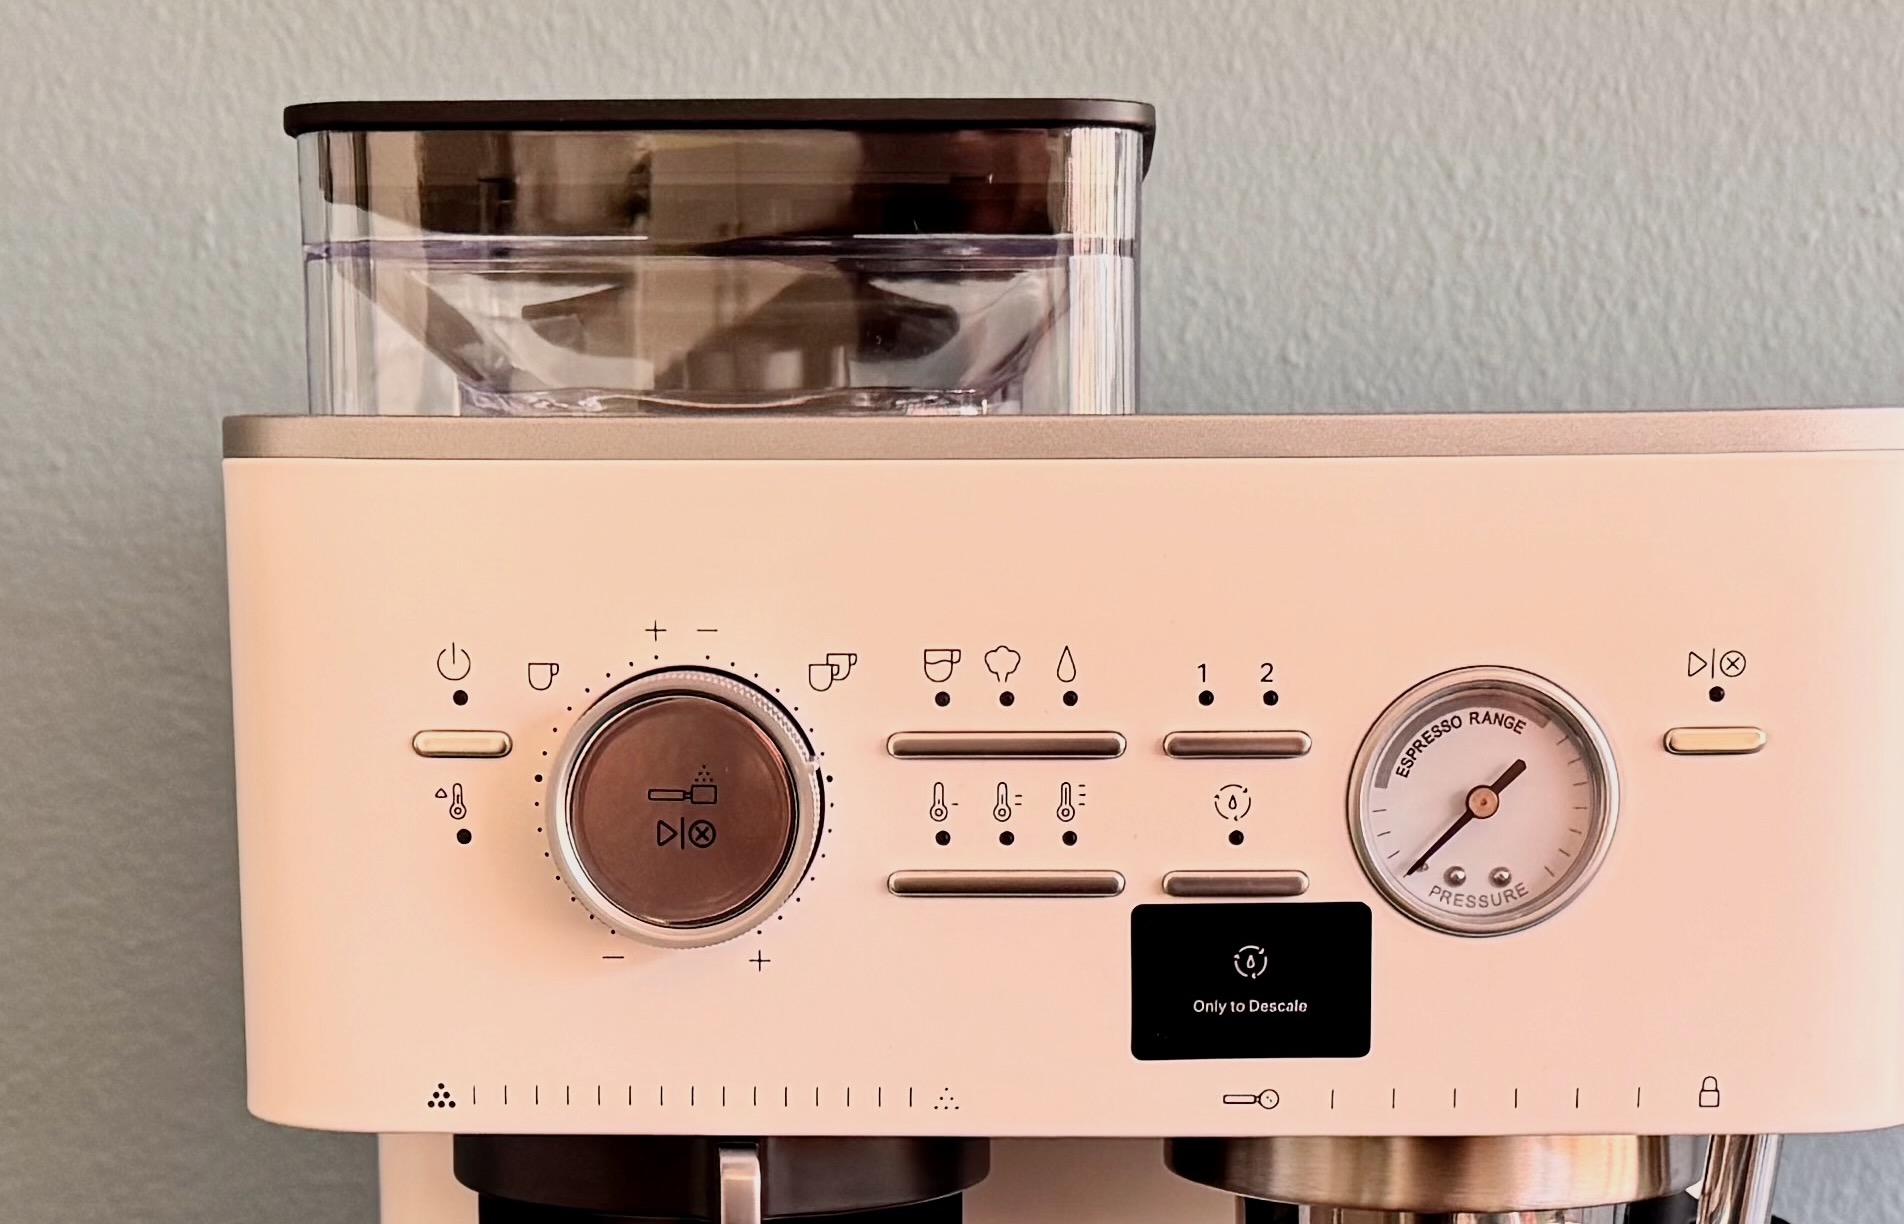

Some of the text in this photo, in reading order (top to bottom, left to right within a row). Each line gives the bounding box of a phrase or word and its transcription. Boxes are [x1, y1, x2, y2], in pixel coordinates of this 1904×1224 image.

[1197, 663, 1206, 683] 1
[1260, 662, 1274, 682] 2
[1395, 710, 1528, 779] ESPRESSO RANGE
[1428, 881, 1530, 909] PRESSURE
[1193, 999, 1308, 1015] Only to Descale
